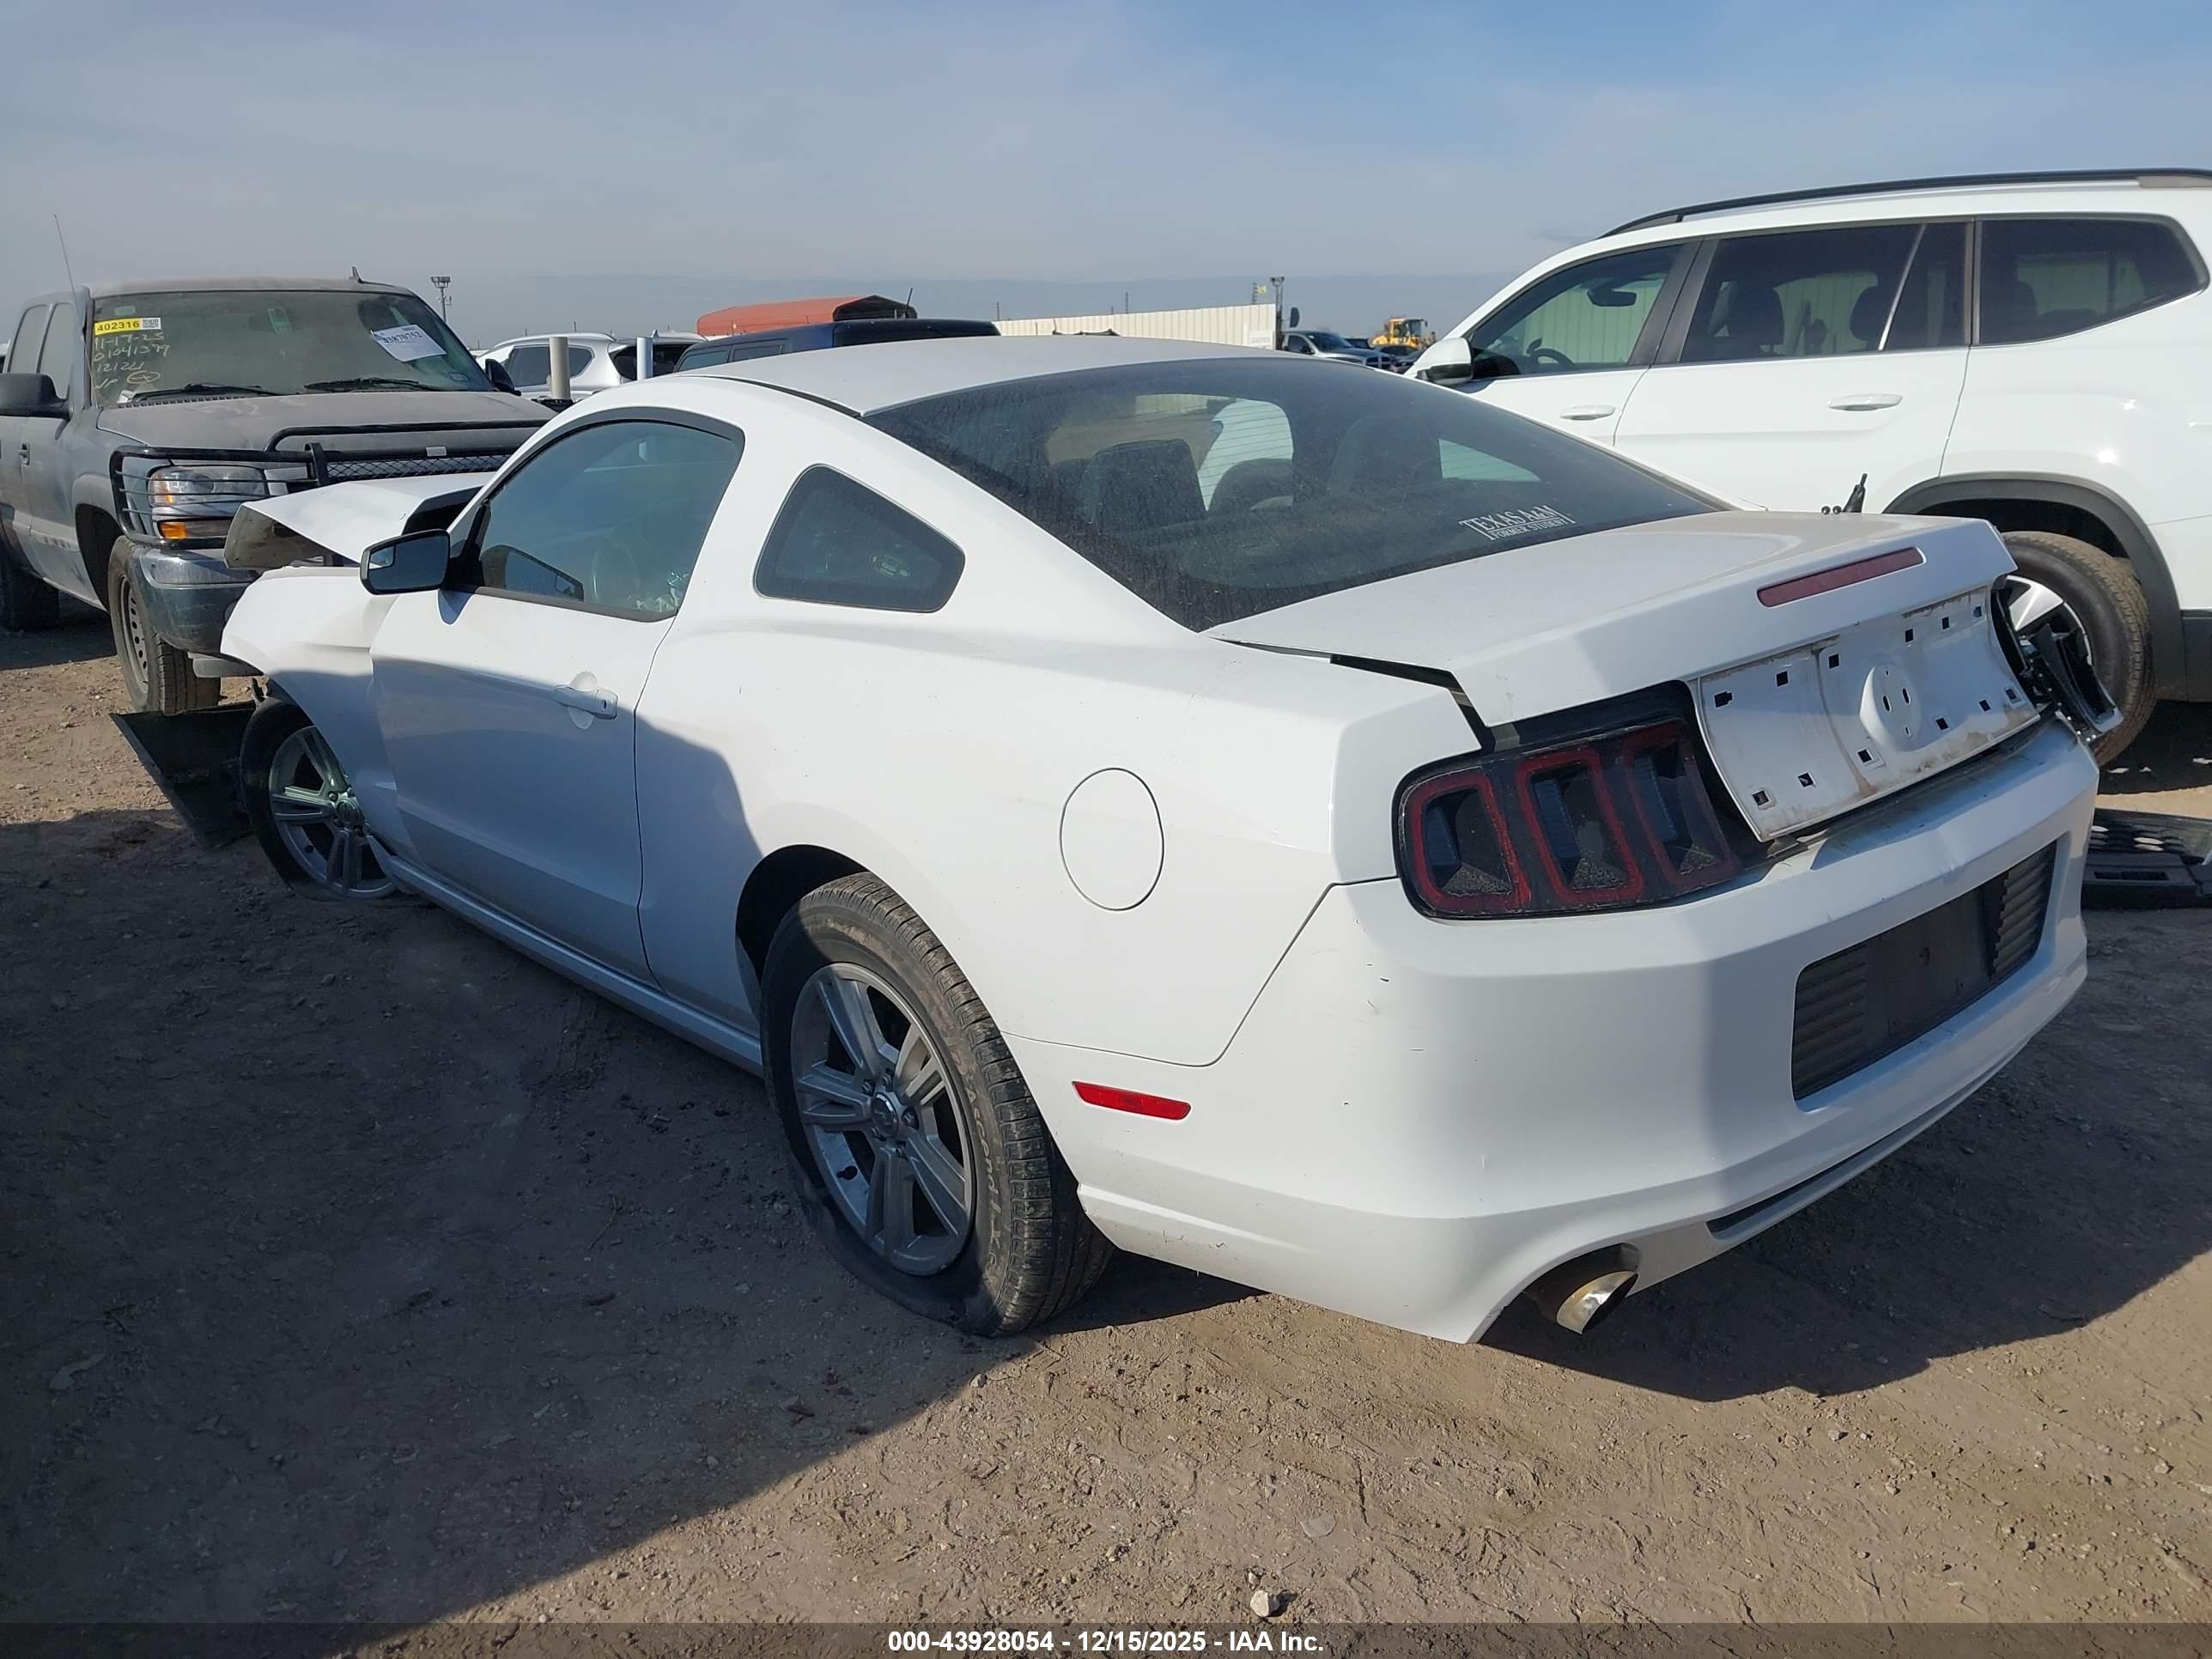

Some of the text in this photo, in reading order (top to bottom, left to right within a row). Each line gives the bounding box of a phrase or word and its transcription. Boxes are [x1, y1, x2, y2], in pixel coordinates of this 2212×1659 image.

[97, 320, 140, 331] 402316
[1458, 504, 1577, 541] TEXAS A&M
[1489, 518, 1569, 539] FORMER STUDENT
[964, 1086, 1000, 1195] Ascend
